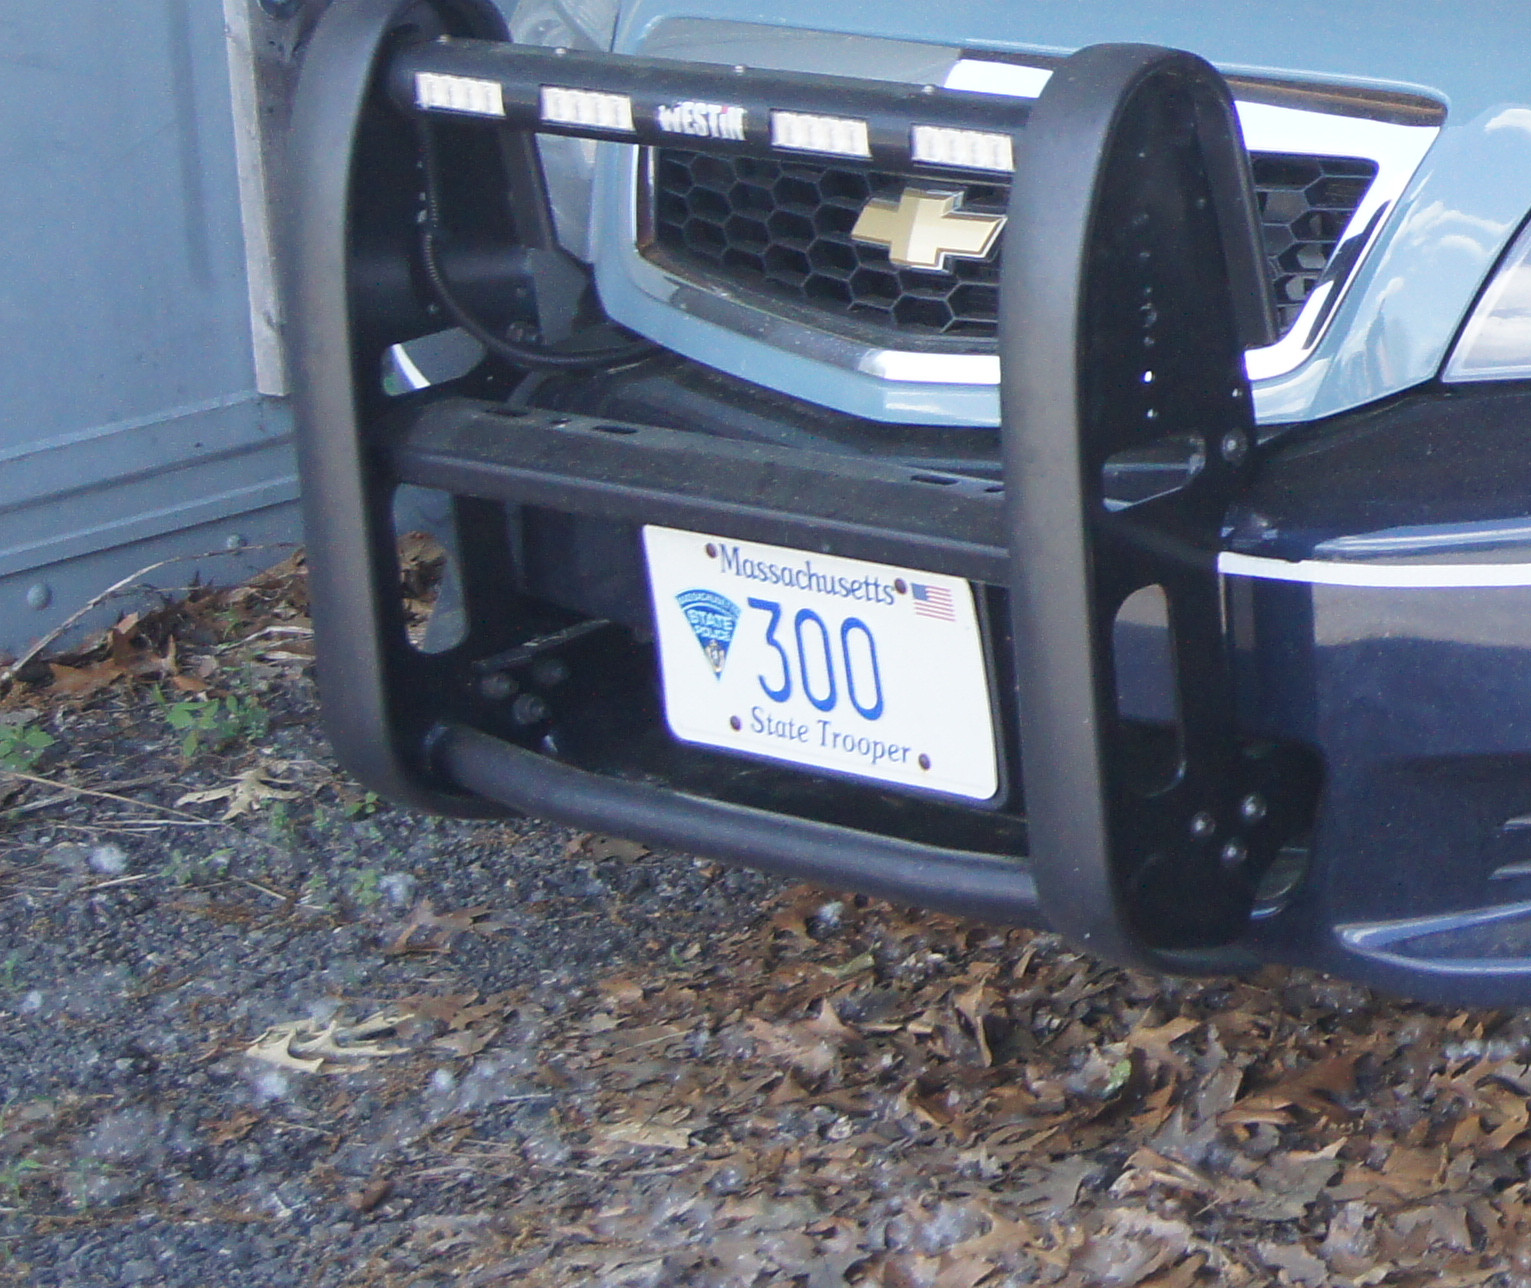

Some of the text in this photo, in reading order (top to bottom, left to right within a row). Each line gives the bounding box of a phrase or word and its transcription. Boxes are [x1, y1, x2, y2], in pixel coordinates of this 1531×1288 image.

[718, 544, 895, 606] Massachusetts
[747, 596, 884, 721] 300
[750, 707, 912, 765] State Trooper
